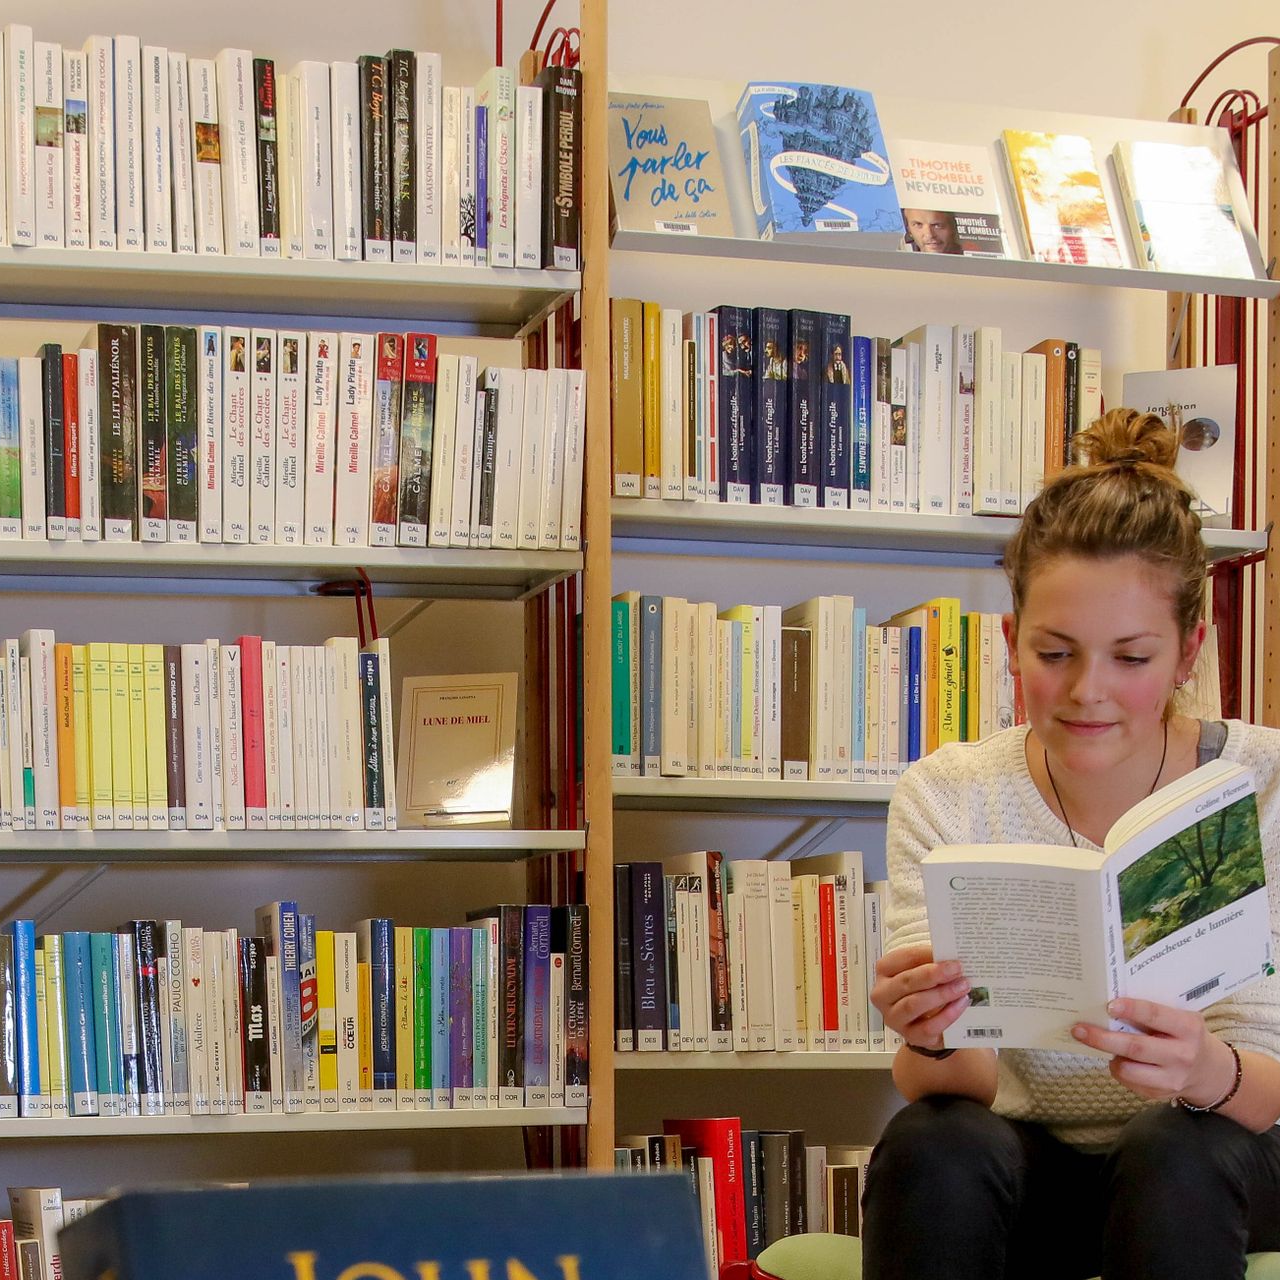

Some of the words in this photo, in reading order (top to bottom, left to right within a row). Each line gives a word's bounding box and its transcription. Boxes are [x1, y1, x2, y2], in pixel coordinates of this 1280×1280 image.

[556, 86, 576, 95] BROWN
[563, 111, 573, 149] PERDU
[622, 114, 668, 149] Vous
[499, 134, 508, 171] d'Oscar
[909, 158, 972, 173] TIMOTHÉE
[555, 151, 573, 207] SYMBOLE
[619, 142, 710, 201] parler
[901, 169, 918, 179] DE
[921, 171, 985, 184] FOMBELLE
[500, 173, 510, 211] beignets
[651, 178, 679, 206] de
[684, 177, 714, 202] ça
[906, 181, 985, 197] NEVERLAND
[561, 205, 569, 217] LE
[955, 217, 987, 227] TIMOTHÉE
[967, 226, 1000, 236] FOMBELLE
[111, 338, 119, 398] D'ALIÉNOR
[314, 361, 323, 384] Pirate
[346, 359, 356, 384] Pirate
[315, 386, 323, 406] Lady
[346, 386, 355, 405] Lady
[282, 396, 290, 425] Chant
[113, 421, 120, 436] LE
[231, 427, 237, 440] Le
[283, 428, 290, 440] Le
[315, 412, 325, 440] Calmel
[349, 412, 358, 441] Calmel
[316, 443, 324, 473] Mireille
[350, 443, 358, 473] Mireille
[423, 717, 448, 726] LUNE
[451, 717, 464, 725] DE
[468, 715, 491, 724] MIEL
[284, 912, 295, 943] COHEN
[571, 916, 581, 955] Cornwell
[642, 914, 655, 961] Sèvres
[1129, 935, 1192, 976] L'accoucheuse
[1195, 928, 1206, 938] de
[1210, 908, 1245, 930] lumière
[286, 944, 296, 971] THIERRY
[647, 962, 655, 975] de
[572, 957, 582, 991] Bernard
[641, 977, 656, 1011] Bleu
[249, 1005, 263, 1042] Max
[347, 1017, 356, 1050] CŒUR
